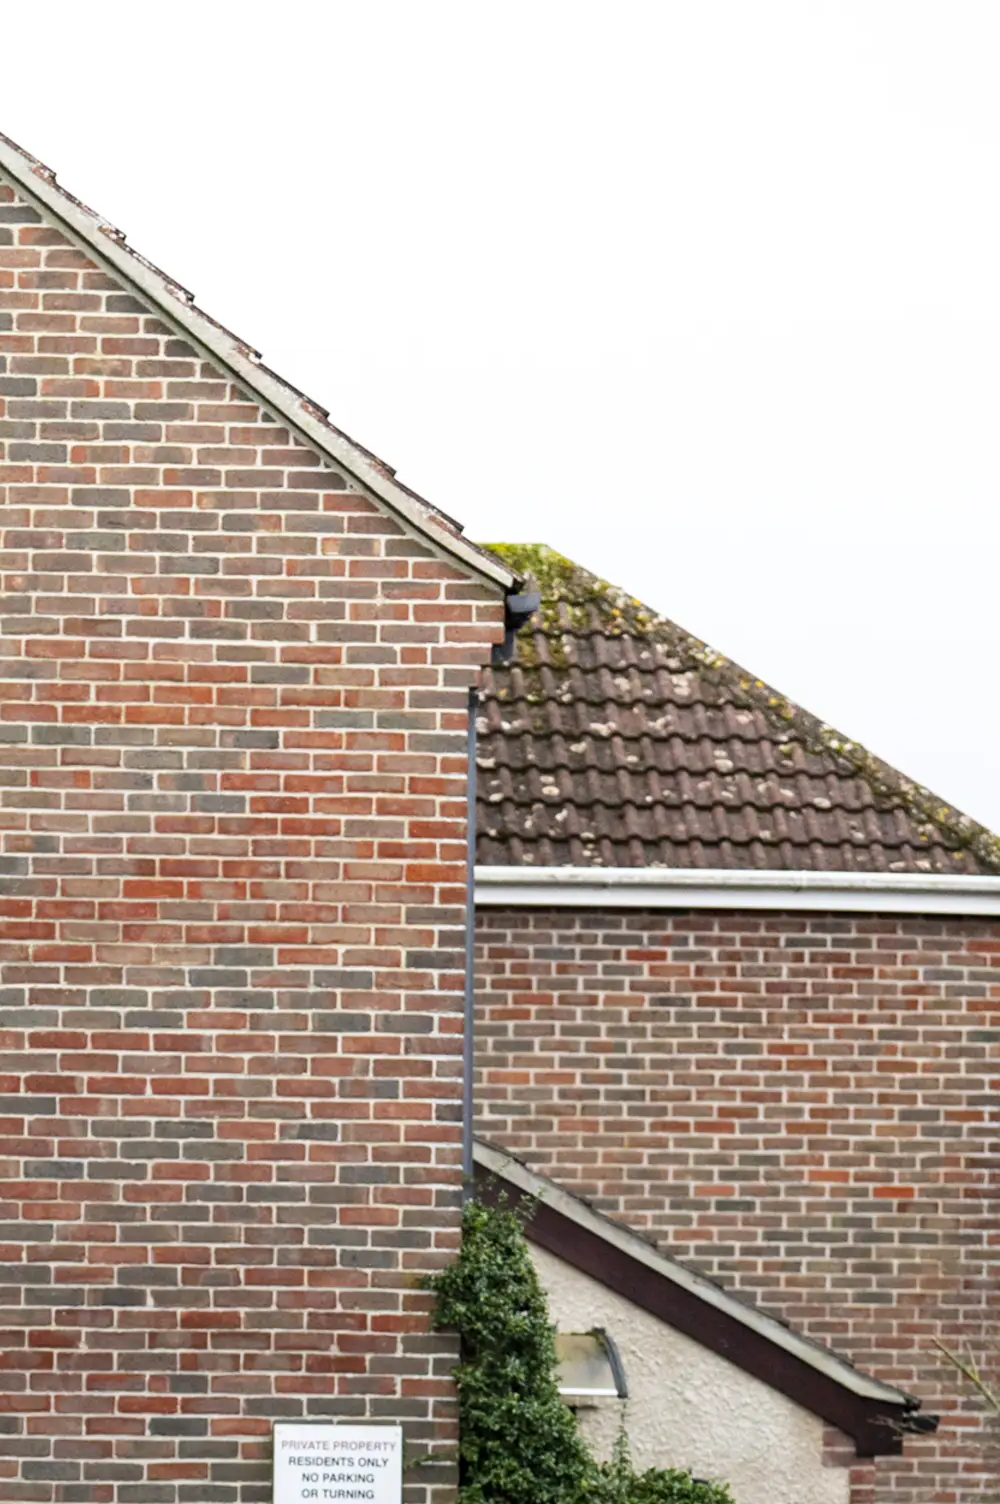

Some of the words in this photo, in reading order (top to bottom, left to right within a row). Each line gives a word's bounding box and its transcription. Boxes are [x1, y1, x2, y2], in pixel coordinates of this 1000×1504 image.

[281, 1440, 329, 1450] PRIVATE
[333, 1441, 397, 1451] PROPERTY
[288, 1456, 354, 1466] RESIDENTS
[358, 1457, 389, 1467] ONLY
[302, 1473, 319, 1483] NO
[323, 1473, 375, 1483] PARKING
[301, 1489, 318, 1499] OR
[323, 1489, 375, 1499] TURNING
